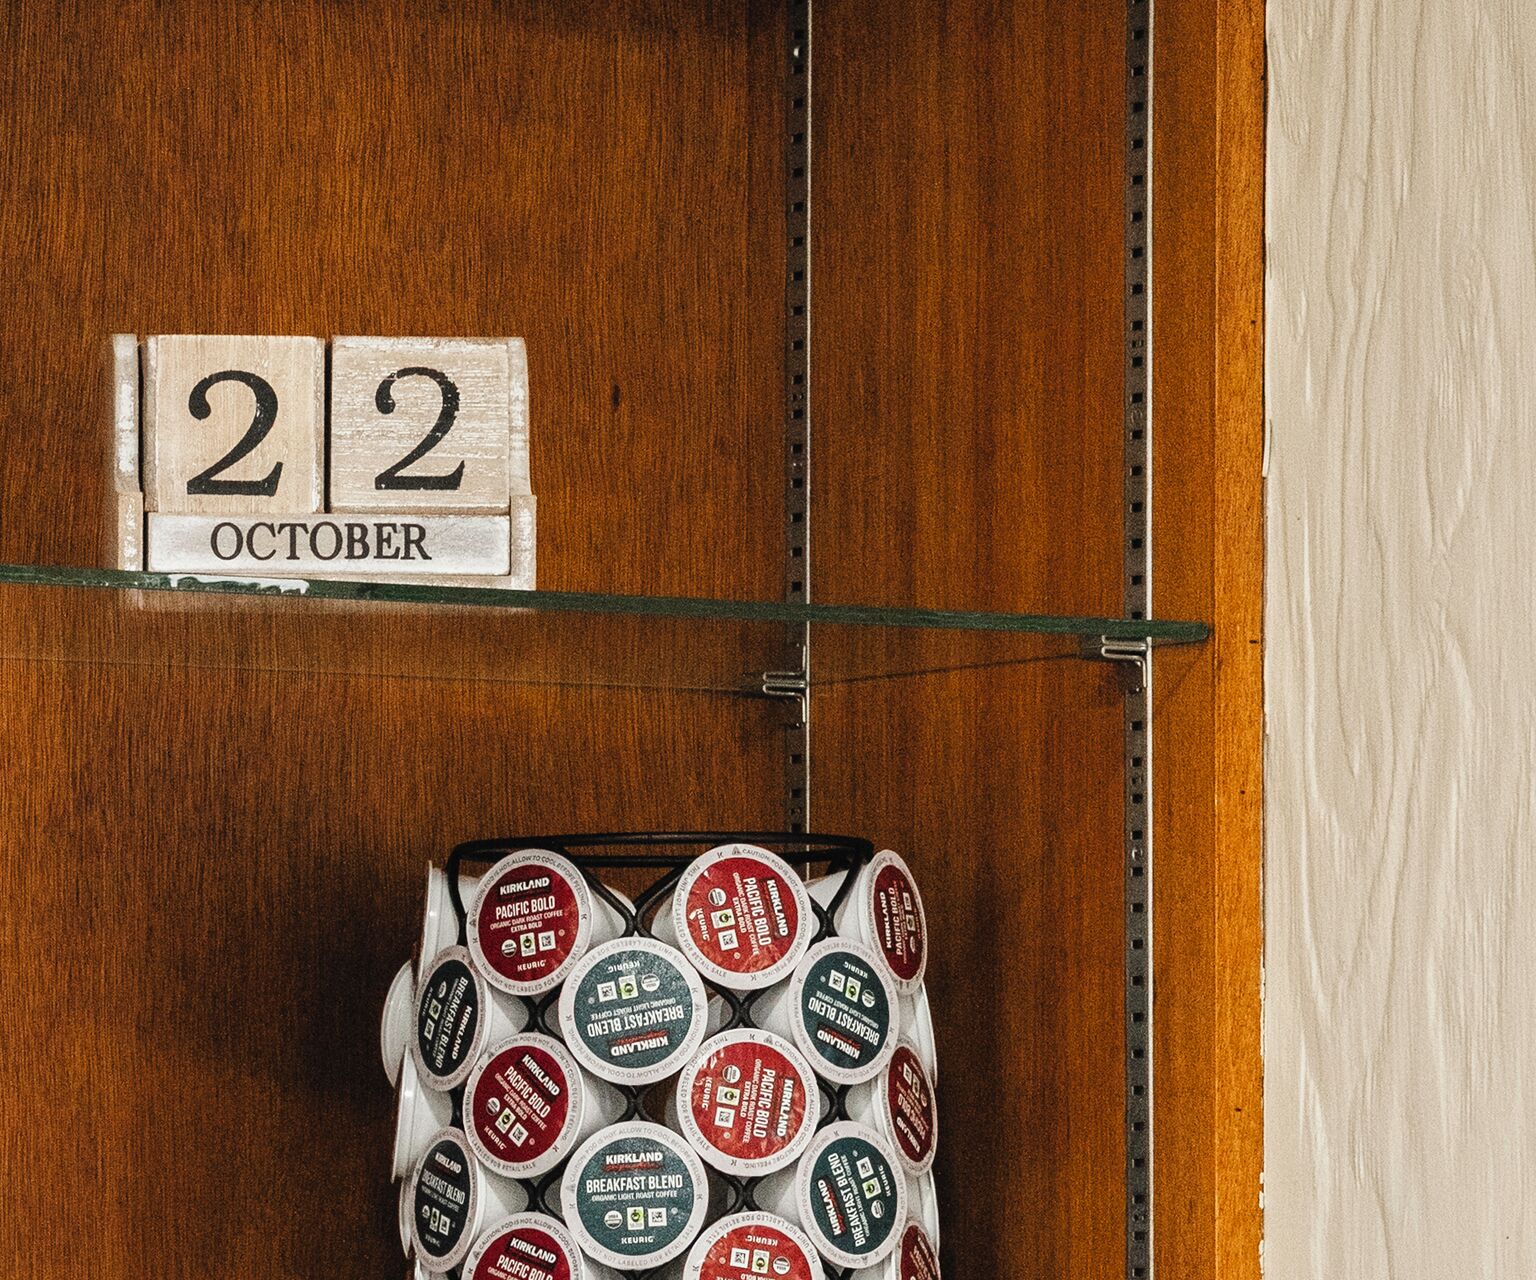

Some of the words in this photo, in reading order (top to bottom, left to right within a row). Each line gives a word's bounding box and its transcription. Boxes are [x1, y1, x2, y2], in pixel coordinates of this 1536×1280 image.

[209, 521, 433, 562] OCTOBER
[499, 877, 550, 896] KIRKLAND
[732, 871, 746, 898] ORGANIC
[742, 877, 765, 917] PACIFIC
[495, 900, 530, 920] PACIFIC
[530, 895, 556, 913] BOLD
[732, 896, 743, 917] EXTRA
[739, 897, 750, 914] DARK
[766, 879, 789, 936] KIRKLAND
[888, 887, 899, 914] BOLD
[489, 919, 512, 931] ORGANIC
[511, 917, 526, 926] DARK
[525, 912, 543, 923] ROAST
[543, 909, 563, 920] COFFEE
[510, 923, 528, 934] EXTRA
[527, 920, 543, 930] BOLD
[695, 907, 710, 941] KEURIG
[737, 916, 747, 934] BOLD
[743, 913, 755, 933] ROAST
[753, 917, 772, 946] BOLD
[879, 891, 892, 949] KIRKLAND
[748, 933, 761, 957] COFFEE
[892, 916, 903, 956] PACIFIC
[517, 959, 547, 972] KEURIG
[607, 960, 641, 973] KEURIG
[843, 961, 868, 979] KEURIG
[443, 976, 469, 1035] BREAKFAST
[590, 1010, 613, 1021] COFFEE
[613, 1006, 633, 1017] ROAST
[633, 1002, 651, 1013] LIGHT
[649, 997, 676, 1009] ORGANIC
[808, 996, 837, 1021] BLEND
[586, 1017, 623, 1038] BLEND
[623, 1004, 685, 1031] BREAKFAST
[835, 1011, 880, 1046] BREAKFAST
[451, 1005, 473, 1060] KIRKLAND
[816, 1029, 860, 1060] KIRKLAND
[435, 1033, 450, 1069] BLEND
[610, 1035, 669, 1057] KIRKLAND
[522, 1054, 560, 1096] KIRKLAND
[751, 1058, 762, 1085] ORGANIC
[504, 1065, 533, 1099] PACIFIC
[527, 1092, 551, 1118] BOLD
[701, 1076, 713, 1111] KEURIG
[742, 1080, 752, 1101] EXTRA
[748, 1084, 759, 1101] DARK
[757, 1068, 776, 1109] PACIFIC
[494, 1072, 512, 1093] ORGANIC
[508, 1089, 521, 1103] DARK
[518, 1099, 533, 1116] ROAST
[530, 1112, 548, 1131] COFFEE
[503, 1093, 518, 1110] EXTRA
[514, 1106, 528, 1121] BOLD
[739, 1100, 749, 1118] BOLD
[746, 1100, 756, 1121] ROAST
[776, 1078, 794, 1137] KIRKLAND
[742, 1120, 753, 1144] COFFEE
[752, 1109, 770, 1138] BOLD
[483, 1125, 507, 1150] KEURIG
[605, 1151, 664, 1165] KIRKLAND
[827, 1152, 849, 1188] BLEND
[586, 1175, 647, 1194] BREAKFAST
[648, 1174, 683, 1190] BLEND
[878, 1164, 892, 1197] KEURIG
[591, 1193, 617, 1202] ORGANIC
[617, 1192, 635, 1201] LIGHT
[635, 1191, 655, 1200] ROAST
[655, 1189, 678, 1198] COFFEE
[817, 1179, 842, 1236] KIRKLAND
[840, 1187, 866, 1247] BREAKFAST
[510, 1237, 557, 1264] KIRKLAND
[621, 1235, 655, 1245] KEURIG
[745, 1234, 778, 1247] KEURIG
[487, 1266, 508, 1280] ORGANIC
[496, 1254, 530, 1279] PACIFIC
